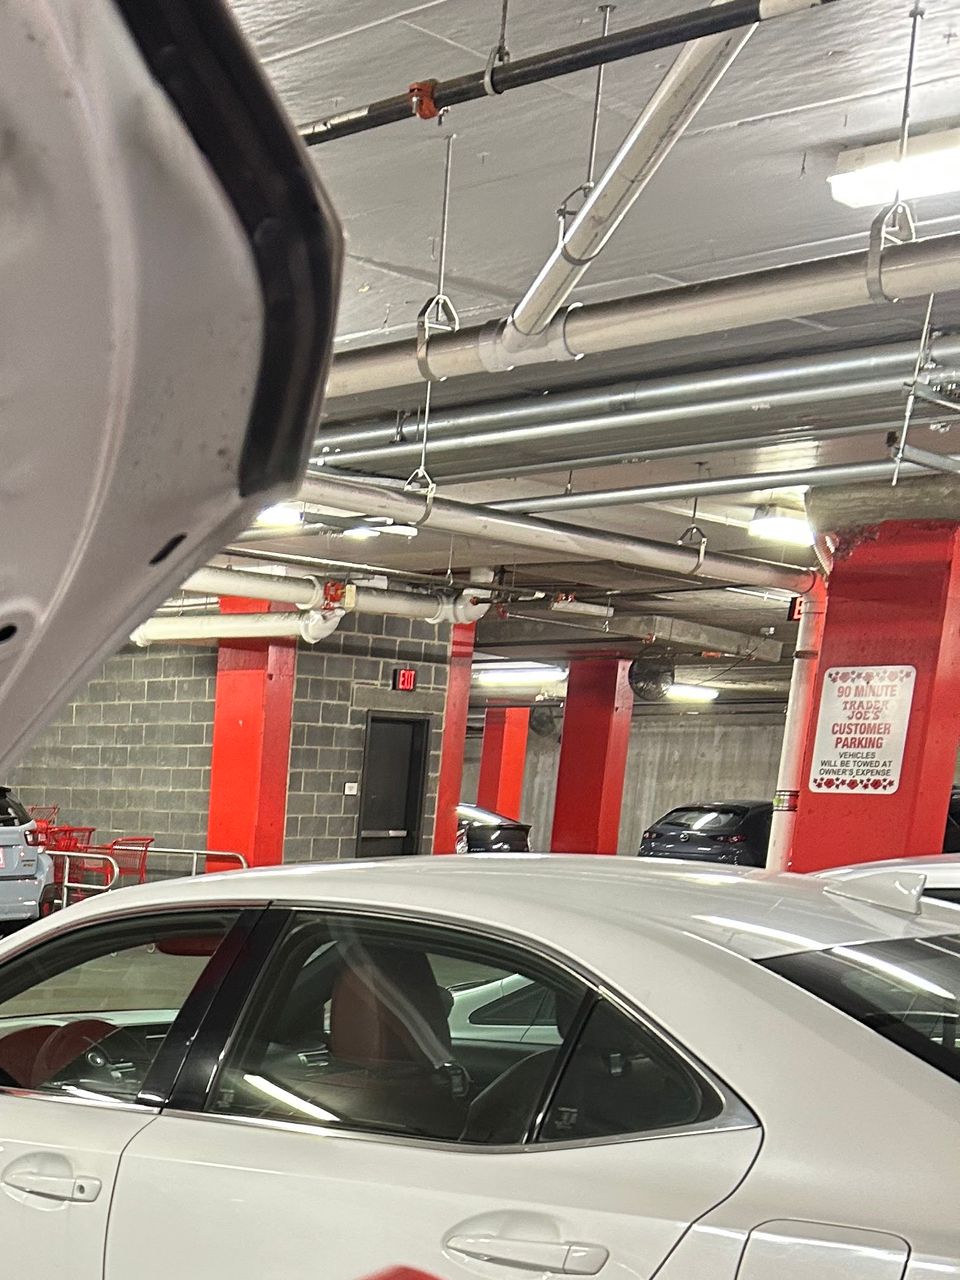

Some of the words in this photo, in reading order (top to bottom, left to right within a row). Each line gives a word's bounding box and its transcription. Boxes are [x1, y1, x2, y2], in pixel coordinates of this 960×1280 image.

[399, 669, 415, 690] EXIT
[837, 685, 851, 698] 90
[854, 684, 897, 698] MINUTE
[842, 700, 889, 711] TRADER
[847, 709, 882, 720] JOE'S
[832, 722, 892, 735] CUSTOMER
[834, 736, 883, 749] PARKING
[838, 751, 876, 759] VEHICLES
[820, 760, 838, 768] WILL
[840, 760, 851, 768] BE
[852, 760, 880, 768] TOWED
[881, 760, 893, 768] AT
[819, 768, 854, 776] OWNER'S
[855, 768, 891, 776] EXPENSE
